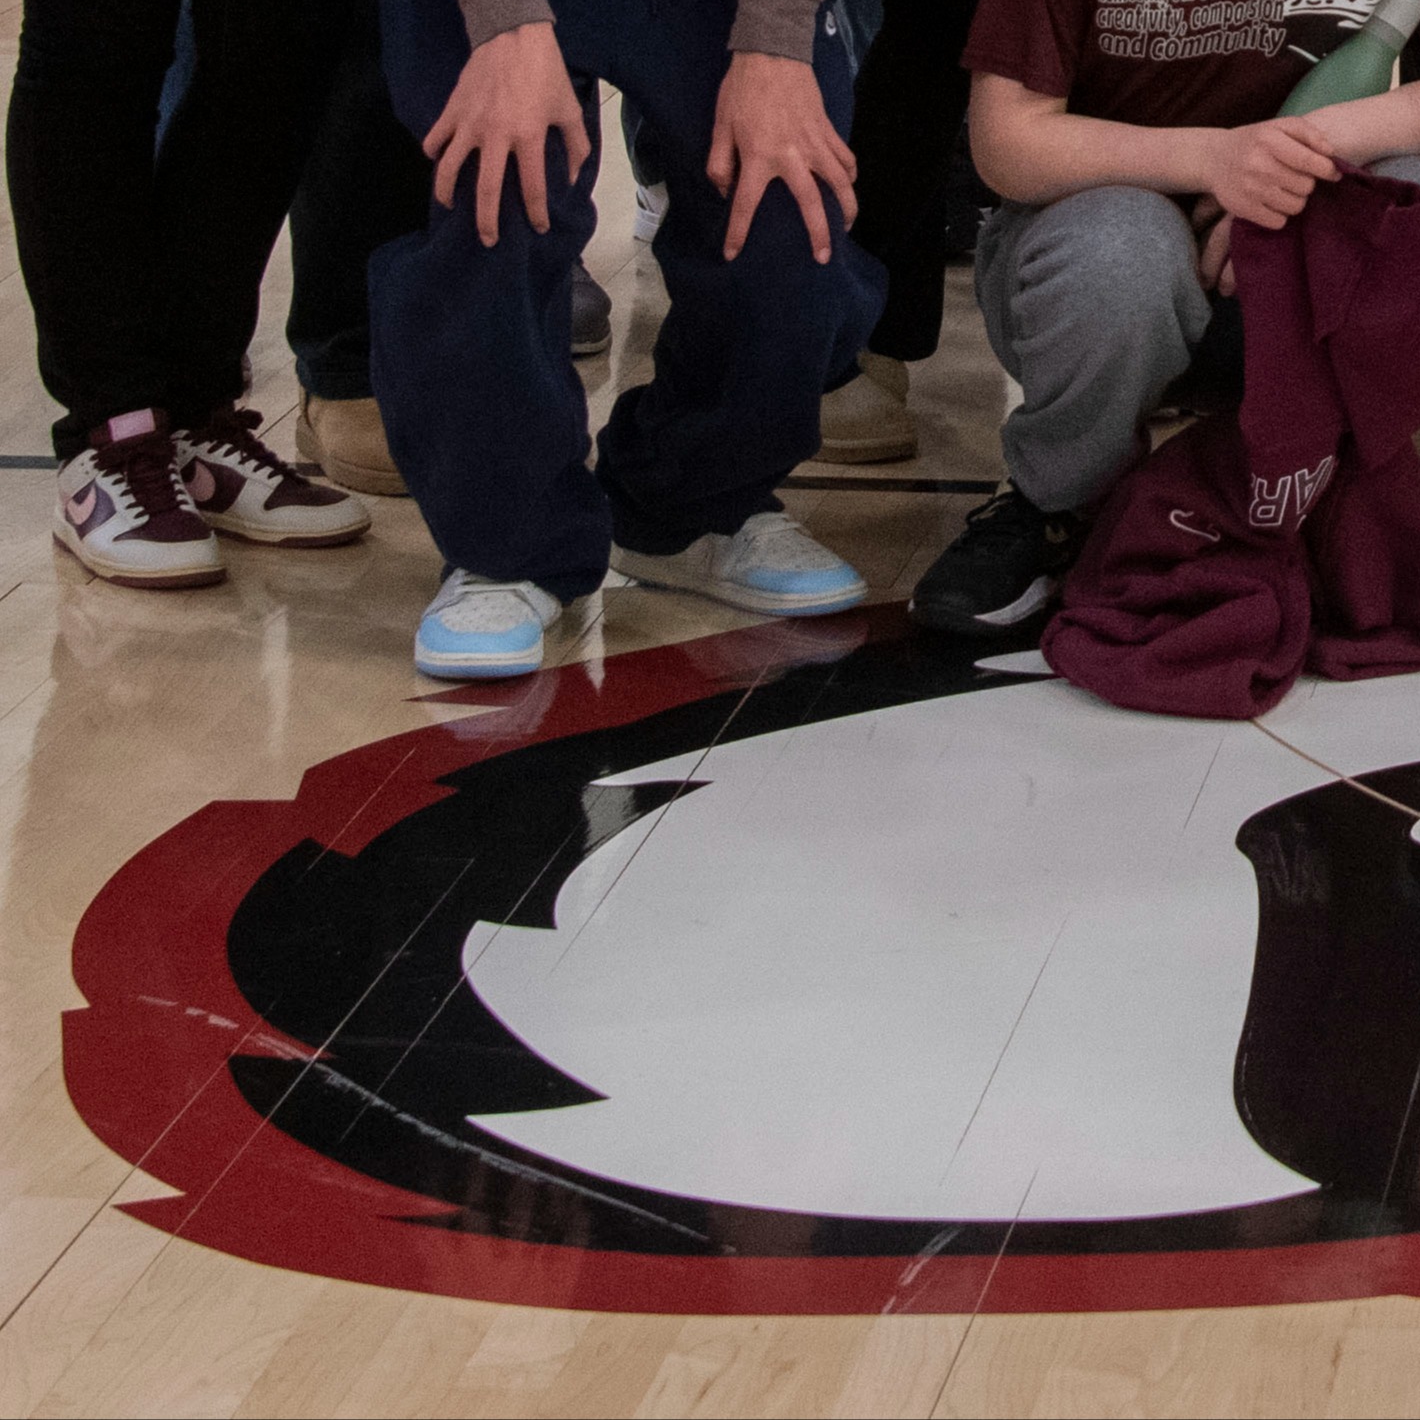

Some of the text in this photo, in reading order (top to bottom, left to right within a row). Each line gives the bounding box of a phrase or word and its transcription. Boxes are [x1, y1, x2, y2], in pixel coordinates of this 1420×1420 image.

[1096, 1, 1187, 36] creativity,
[1100, 25, 1286, 62] and community
